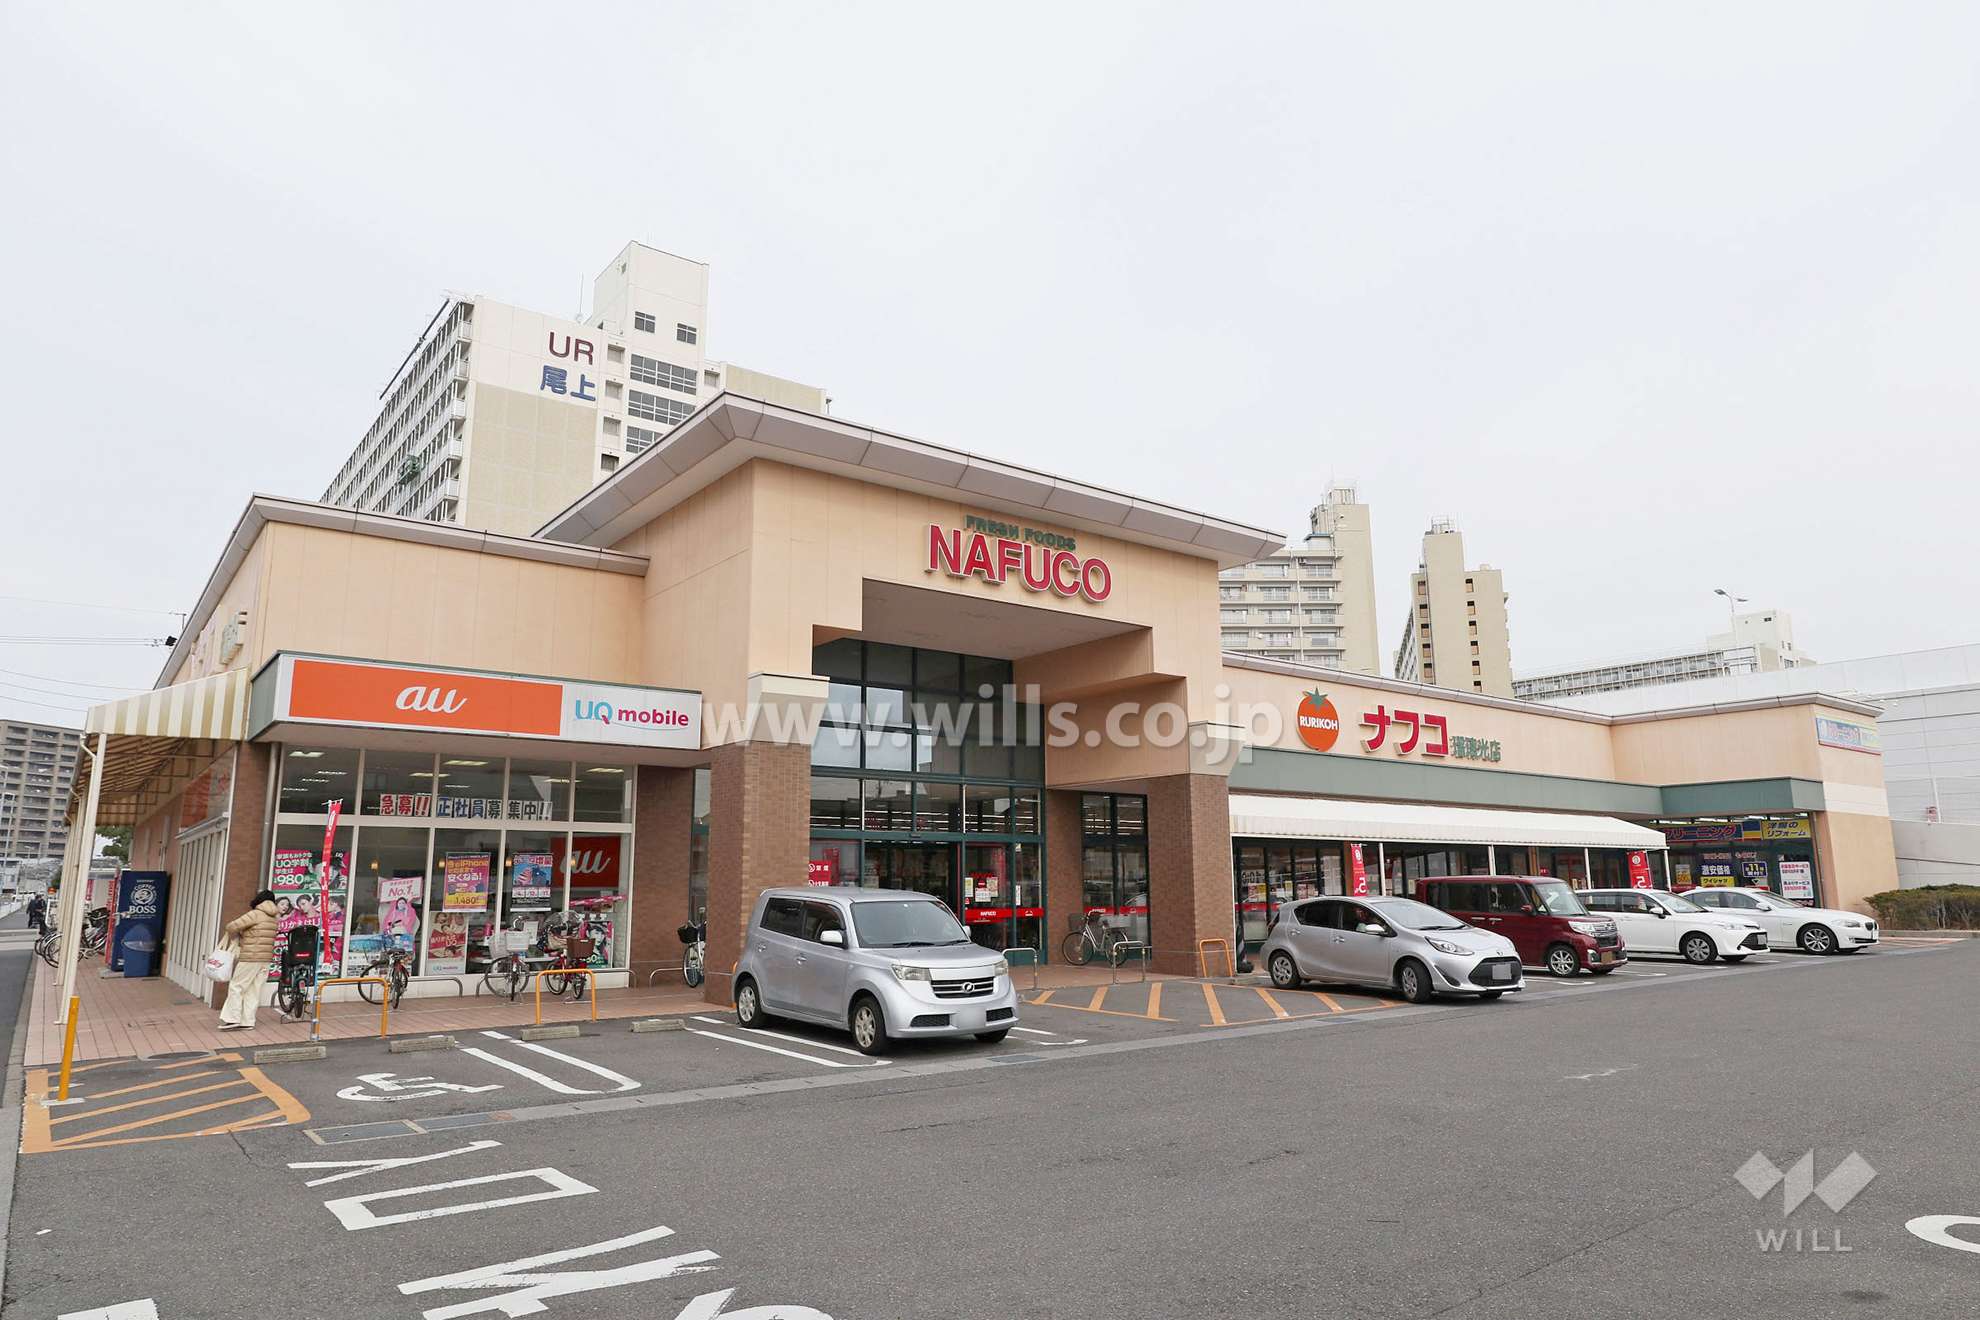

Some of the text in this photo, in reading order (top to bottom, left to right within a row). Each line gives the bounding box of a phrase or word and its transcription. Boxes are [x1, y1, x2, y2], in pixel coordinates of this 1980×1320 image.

[548, 331, 594, 366] UR
[540, 364, 596, 402] 尾上
[965, 514, 1077, 551] FRESH FOODS
[928, 523, 1113, 603] NAFUCO
[395, 685, 468, 714] au
[575, 698, 690, 727] UQ mobile
[1299, 715, 1339, 731] RURIKOH
[1362, 704, 1450, 757] ナフコ
[129, 905, 157, 914] BOSS
